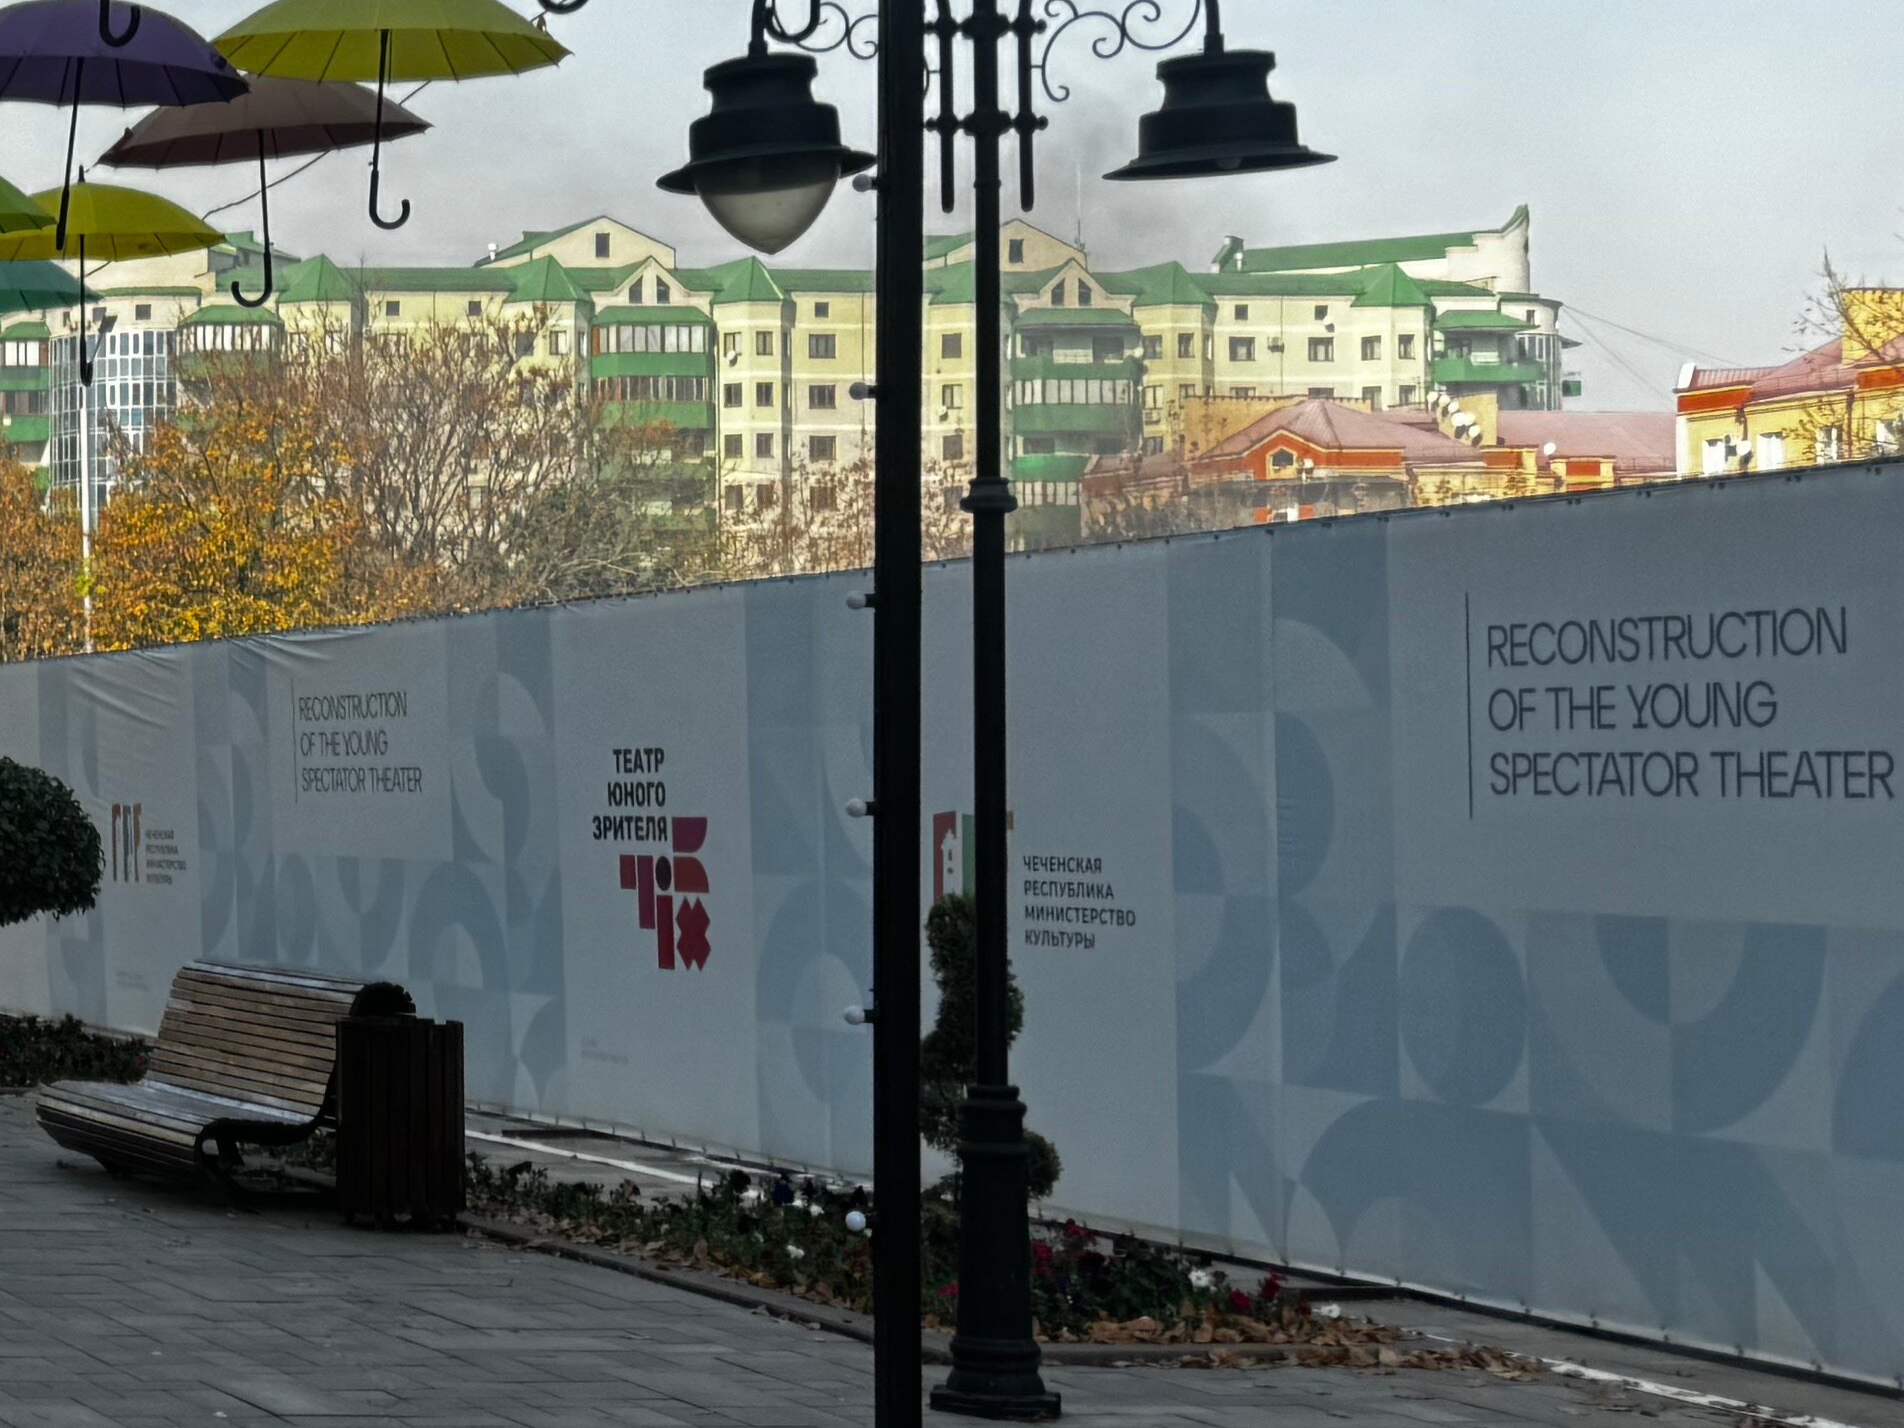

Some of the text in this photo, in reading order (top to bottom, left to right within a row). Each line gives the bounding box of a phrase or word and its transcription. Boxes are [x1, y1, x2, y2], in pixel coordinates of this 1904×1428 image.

[1487, 606, 1847, 668] RECONSTRUCTION
[298, 691, 407, 721] RECONSTRUCTION
[1488, 680, 1778, 731] OF THE YOUNG
[300, 730, 388, 756] OF THE YOUNG
[612, 747, 665, 774] ТЕАТР
[302, 767, 422, 792] SPECTATOR THEATER
[1489, 750, 1896, 799] SPECTATOR THEATER
[607, 781, 666, 807] ЮНОГО
[592, 815, 668, 842] ЗРИТЕЛЯ
[1023, 855, 1102, 873] ЧЕЧЕНСКАЯ
[1024, 880, 1114, 900] РЕСПУБЛИКА
[1025, 906, 1136, 927] МИНИСТЕРСТВО
[1025, 929, 1095, 949] КУЛЬТУРЫ
